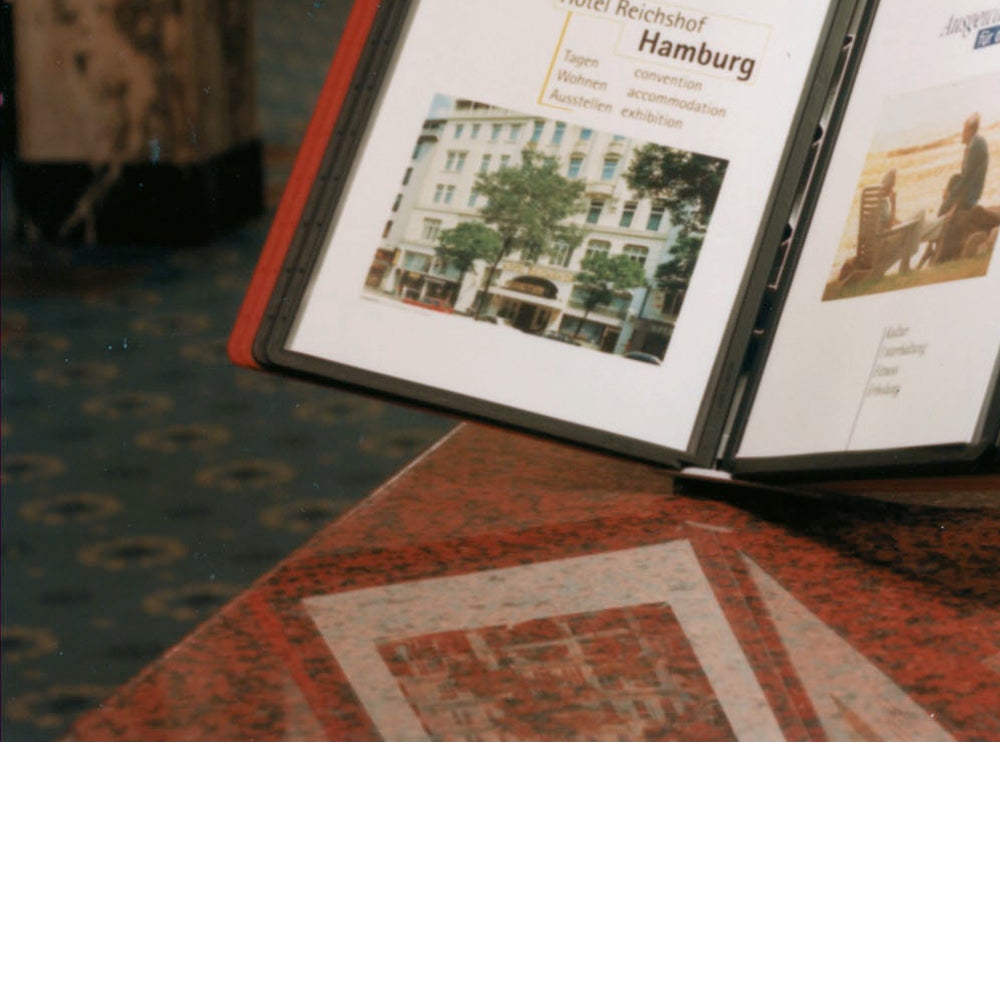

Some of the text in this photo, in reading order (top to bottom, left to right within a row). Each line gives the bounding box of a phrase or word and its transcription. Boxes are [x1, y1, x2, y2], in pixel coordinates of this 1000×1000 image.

[562, 49, 600, 70] Tagen
[638, 28, 756, 82] Hamburg
[556, 69, 609, 92] Wohnen
[633, 67, 704, 92] convention
[549, 88, 614, 114] Ausstellen
[626, 86, 727, 119] accommodation
[621, 106, 684, 130] exhibition
